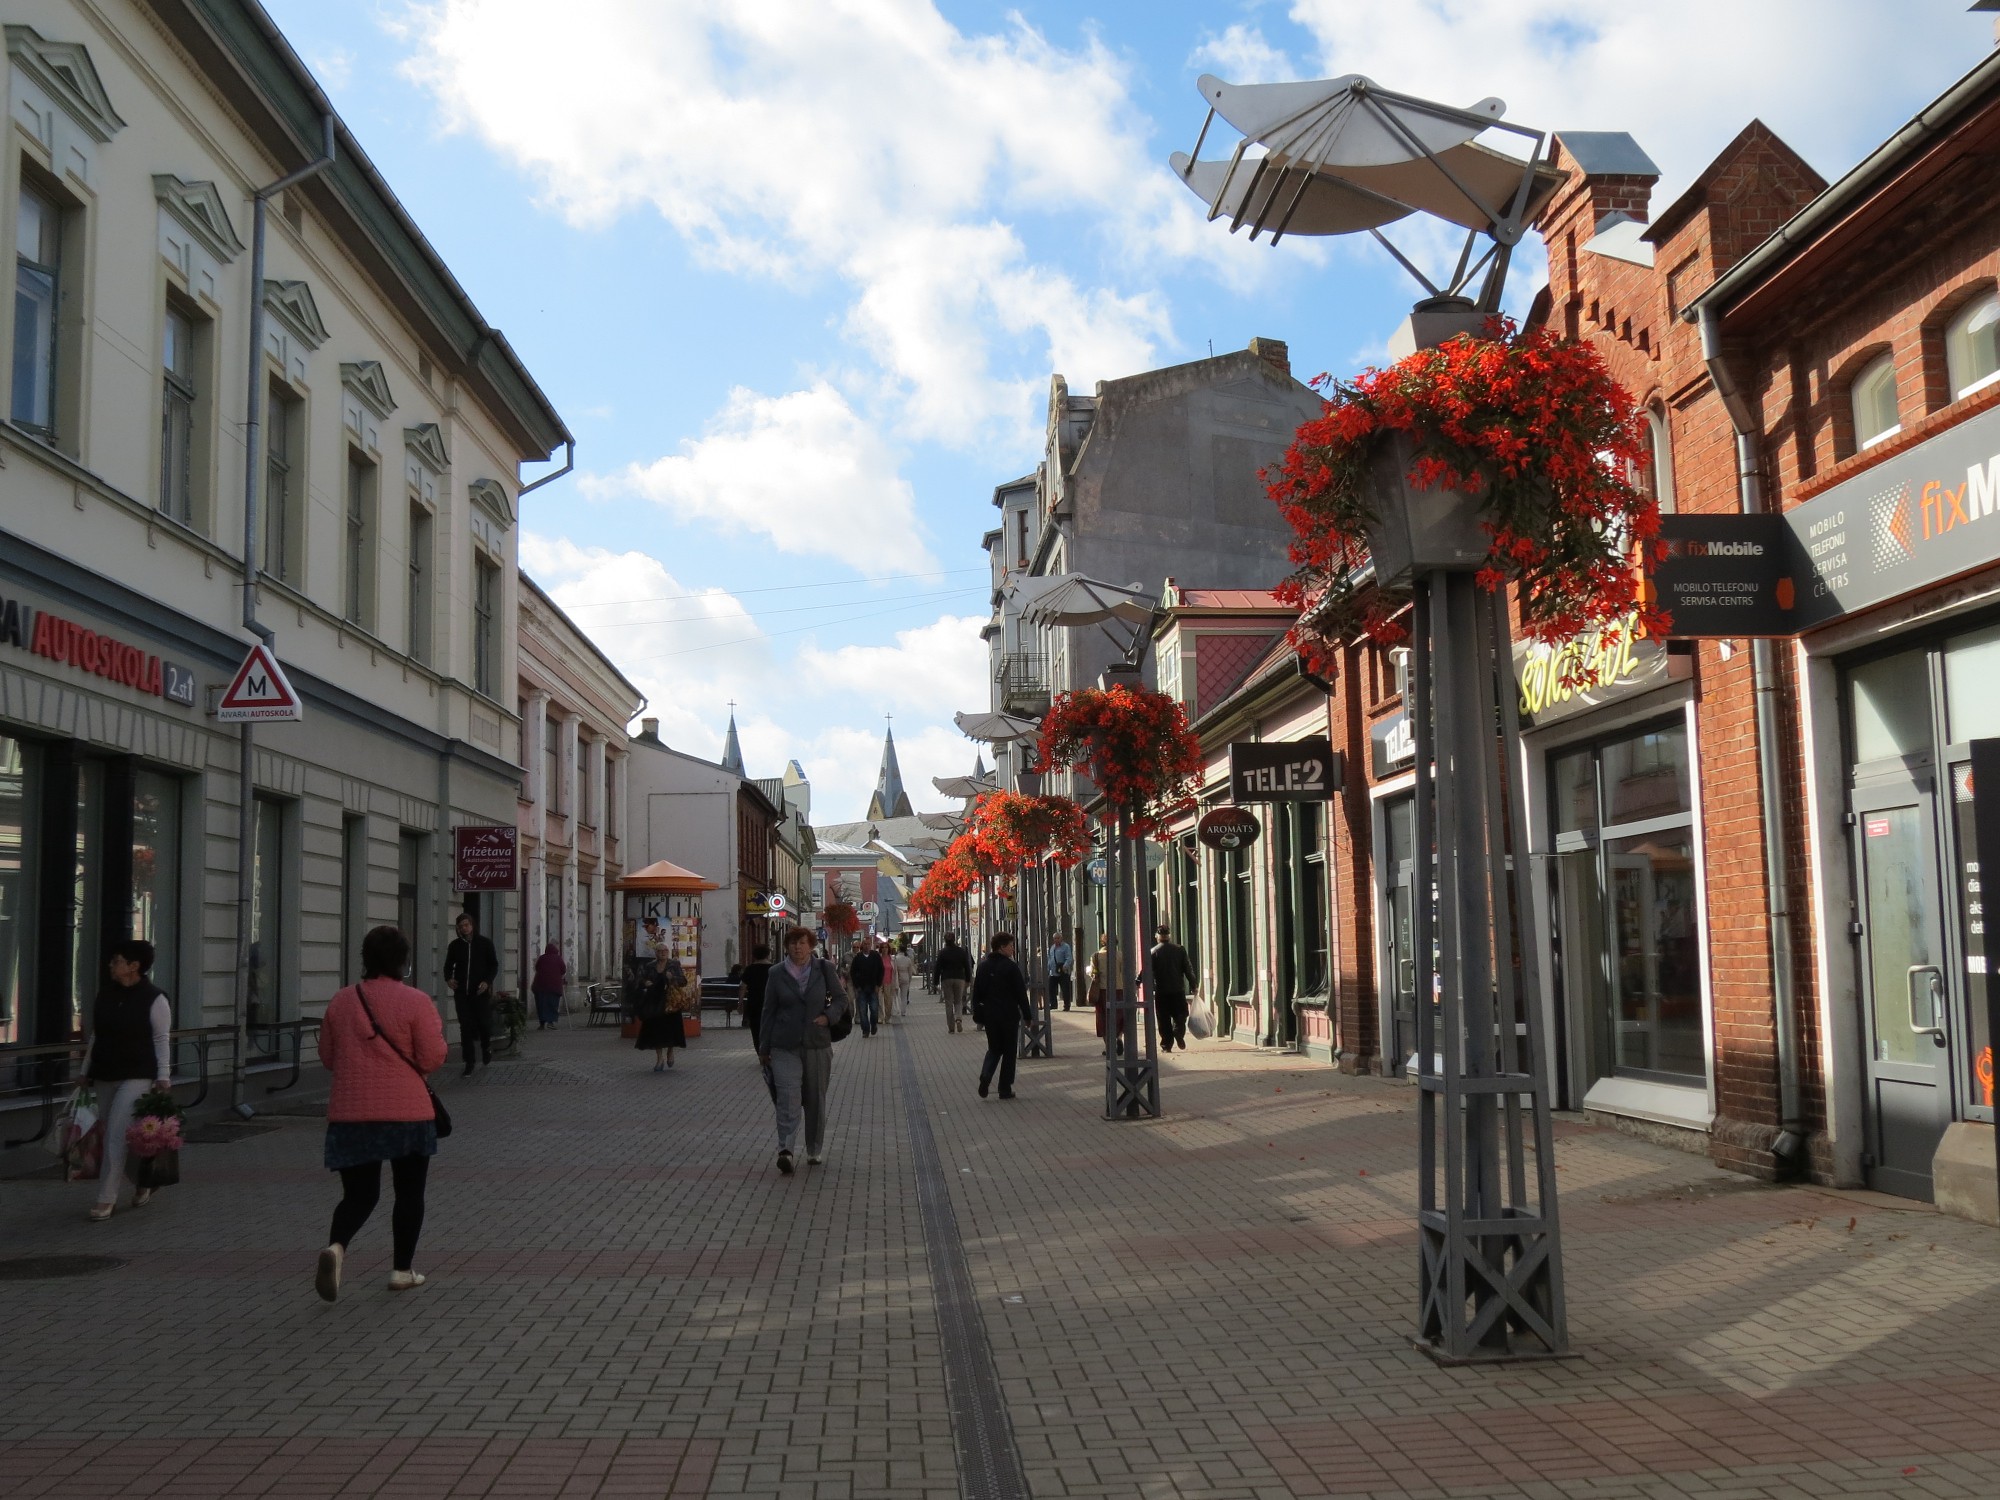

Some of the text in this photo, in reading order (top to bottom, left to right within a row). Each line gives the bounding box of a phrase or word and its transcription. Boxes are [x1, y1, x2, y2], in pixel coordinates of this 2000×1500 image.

[1809, 511, 1845, 539] MOBILO
[1687, 541, 1764, 556] fixMobile
[1810, 531, 1846, 559] TELEFONU
[1812, 552, 1848, 578] SERVISA
[1673, 583, 1759, 593] MOBILO TELEFONU
[1813, 572, 1849, 598] CENTRS
[1680, 596, 1754, 606] SERVISA CENTRS
[31, 610, 163, 697] AUTOSKOLA
[248, 675, 267, 697] M
[250, 709, 294, 718] AUTOSKOLA
[1242, 758, 1325, 792] TELE2
[462, 846, 512, 860] frizētava
[467, 864, 508, 884] Edgars
